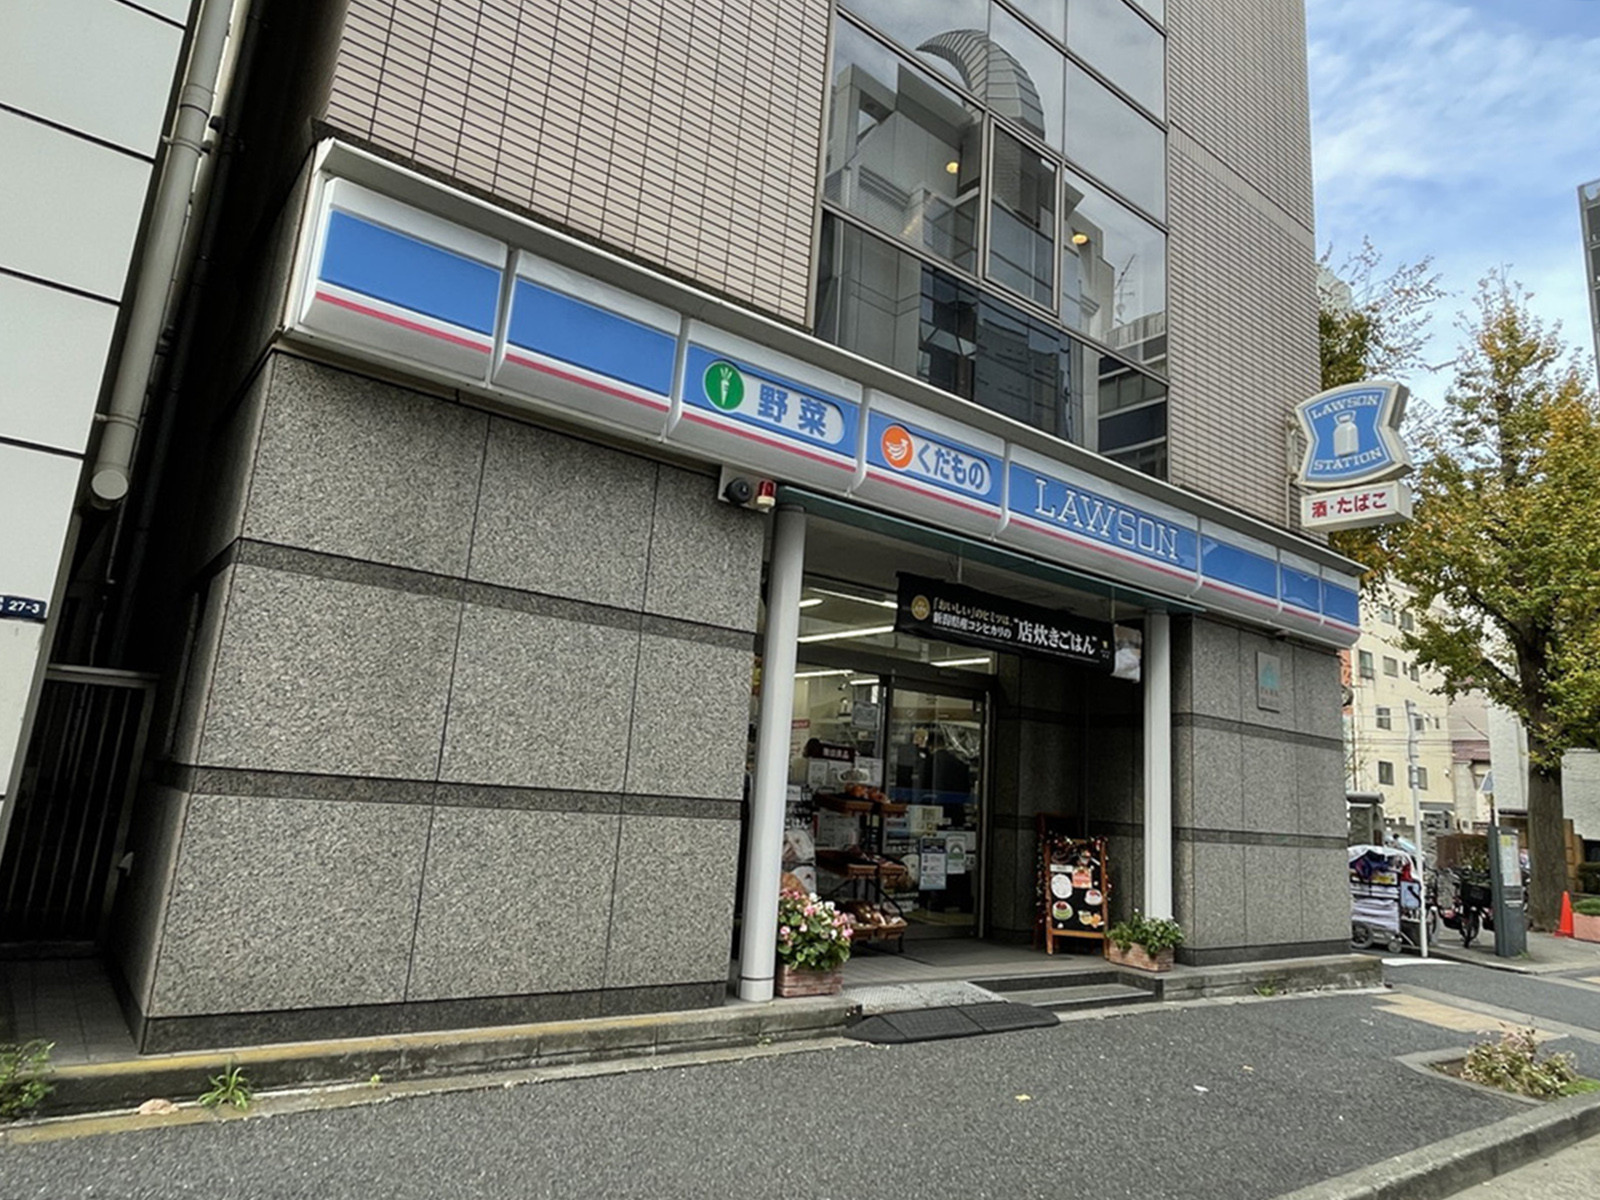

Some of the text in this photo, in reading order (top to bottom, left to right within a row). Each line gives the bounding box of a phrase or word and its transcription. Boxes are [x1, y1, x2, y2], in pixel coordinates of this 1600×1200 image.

[758, 383, 827, 438] 野菜
[1310, 394, 1380, 420] LAWSON
[917, 442, 985, 490] くだもの
[1313, 447, 1383, 471] STATION
[1034, 477, 1179, 561] LAWSON
[1311, 492, 1388, 519] 酒・たばこ
[7, 600, 41, 614] 27-3
